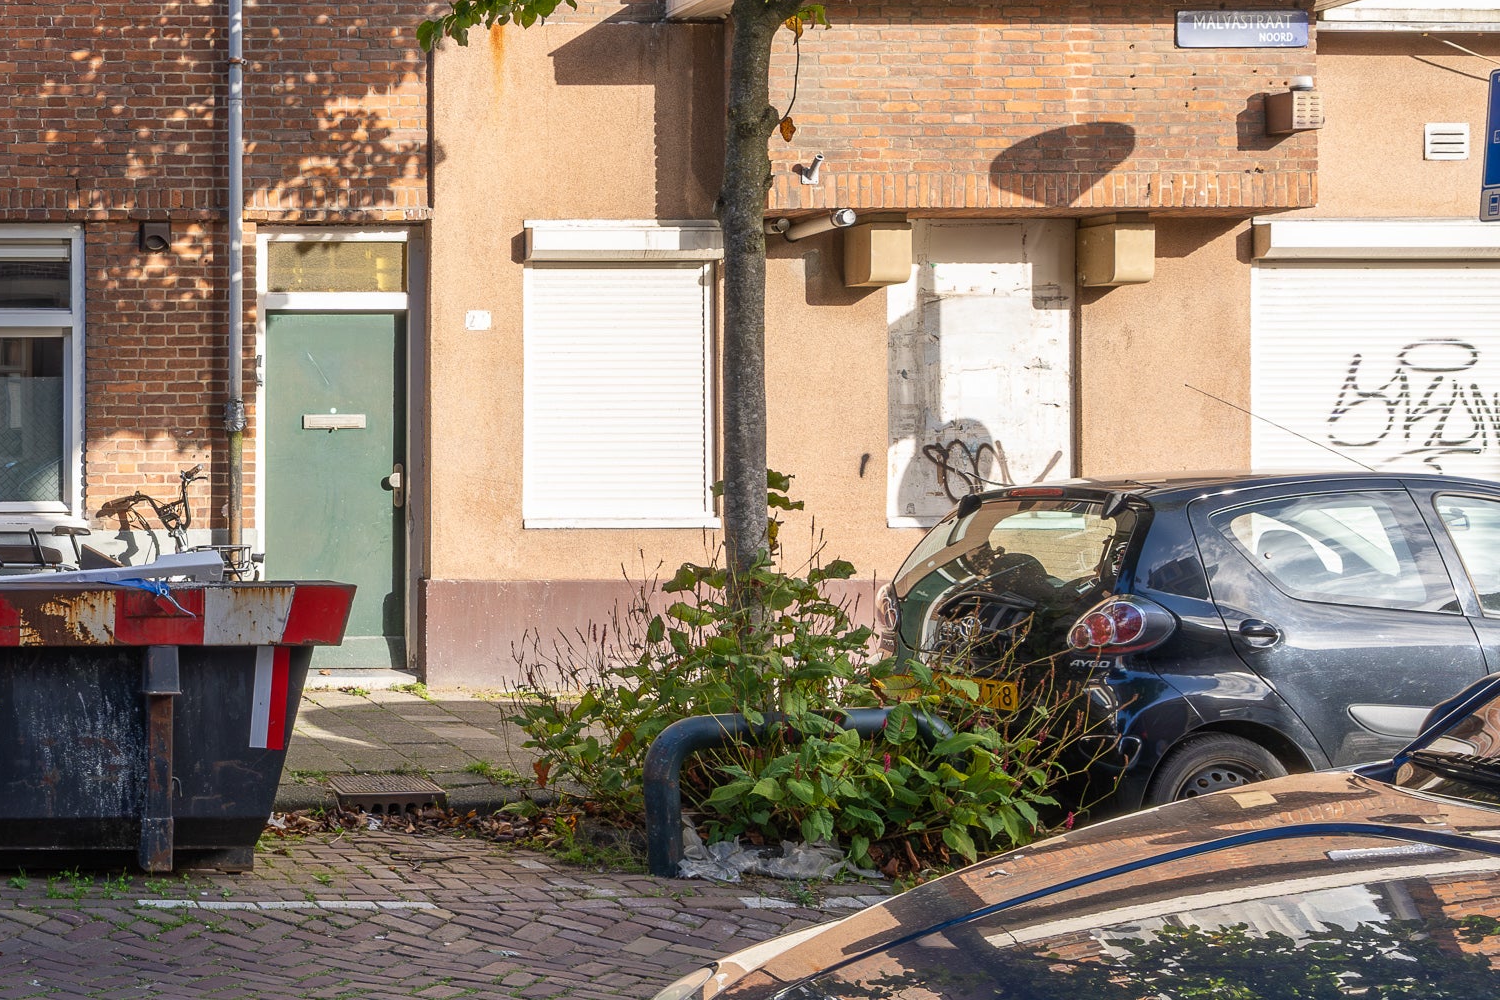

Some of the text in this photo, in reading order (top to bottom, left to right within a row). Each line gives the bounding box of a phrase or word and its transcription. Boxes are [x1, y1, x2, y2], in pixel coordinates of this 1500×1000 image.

[1193, 14, 1293, 30] MALVASTRAAT
[1258, 32, 1293, 42] NOORD
[1069, 659, 1111, 668] AYGO
